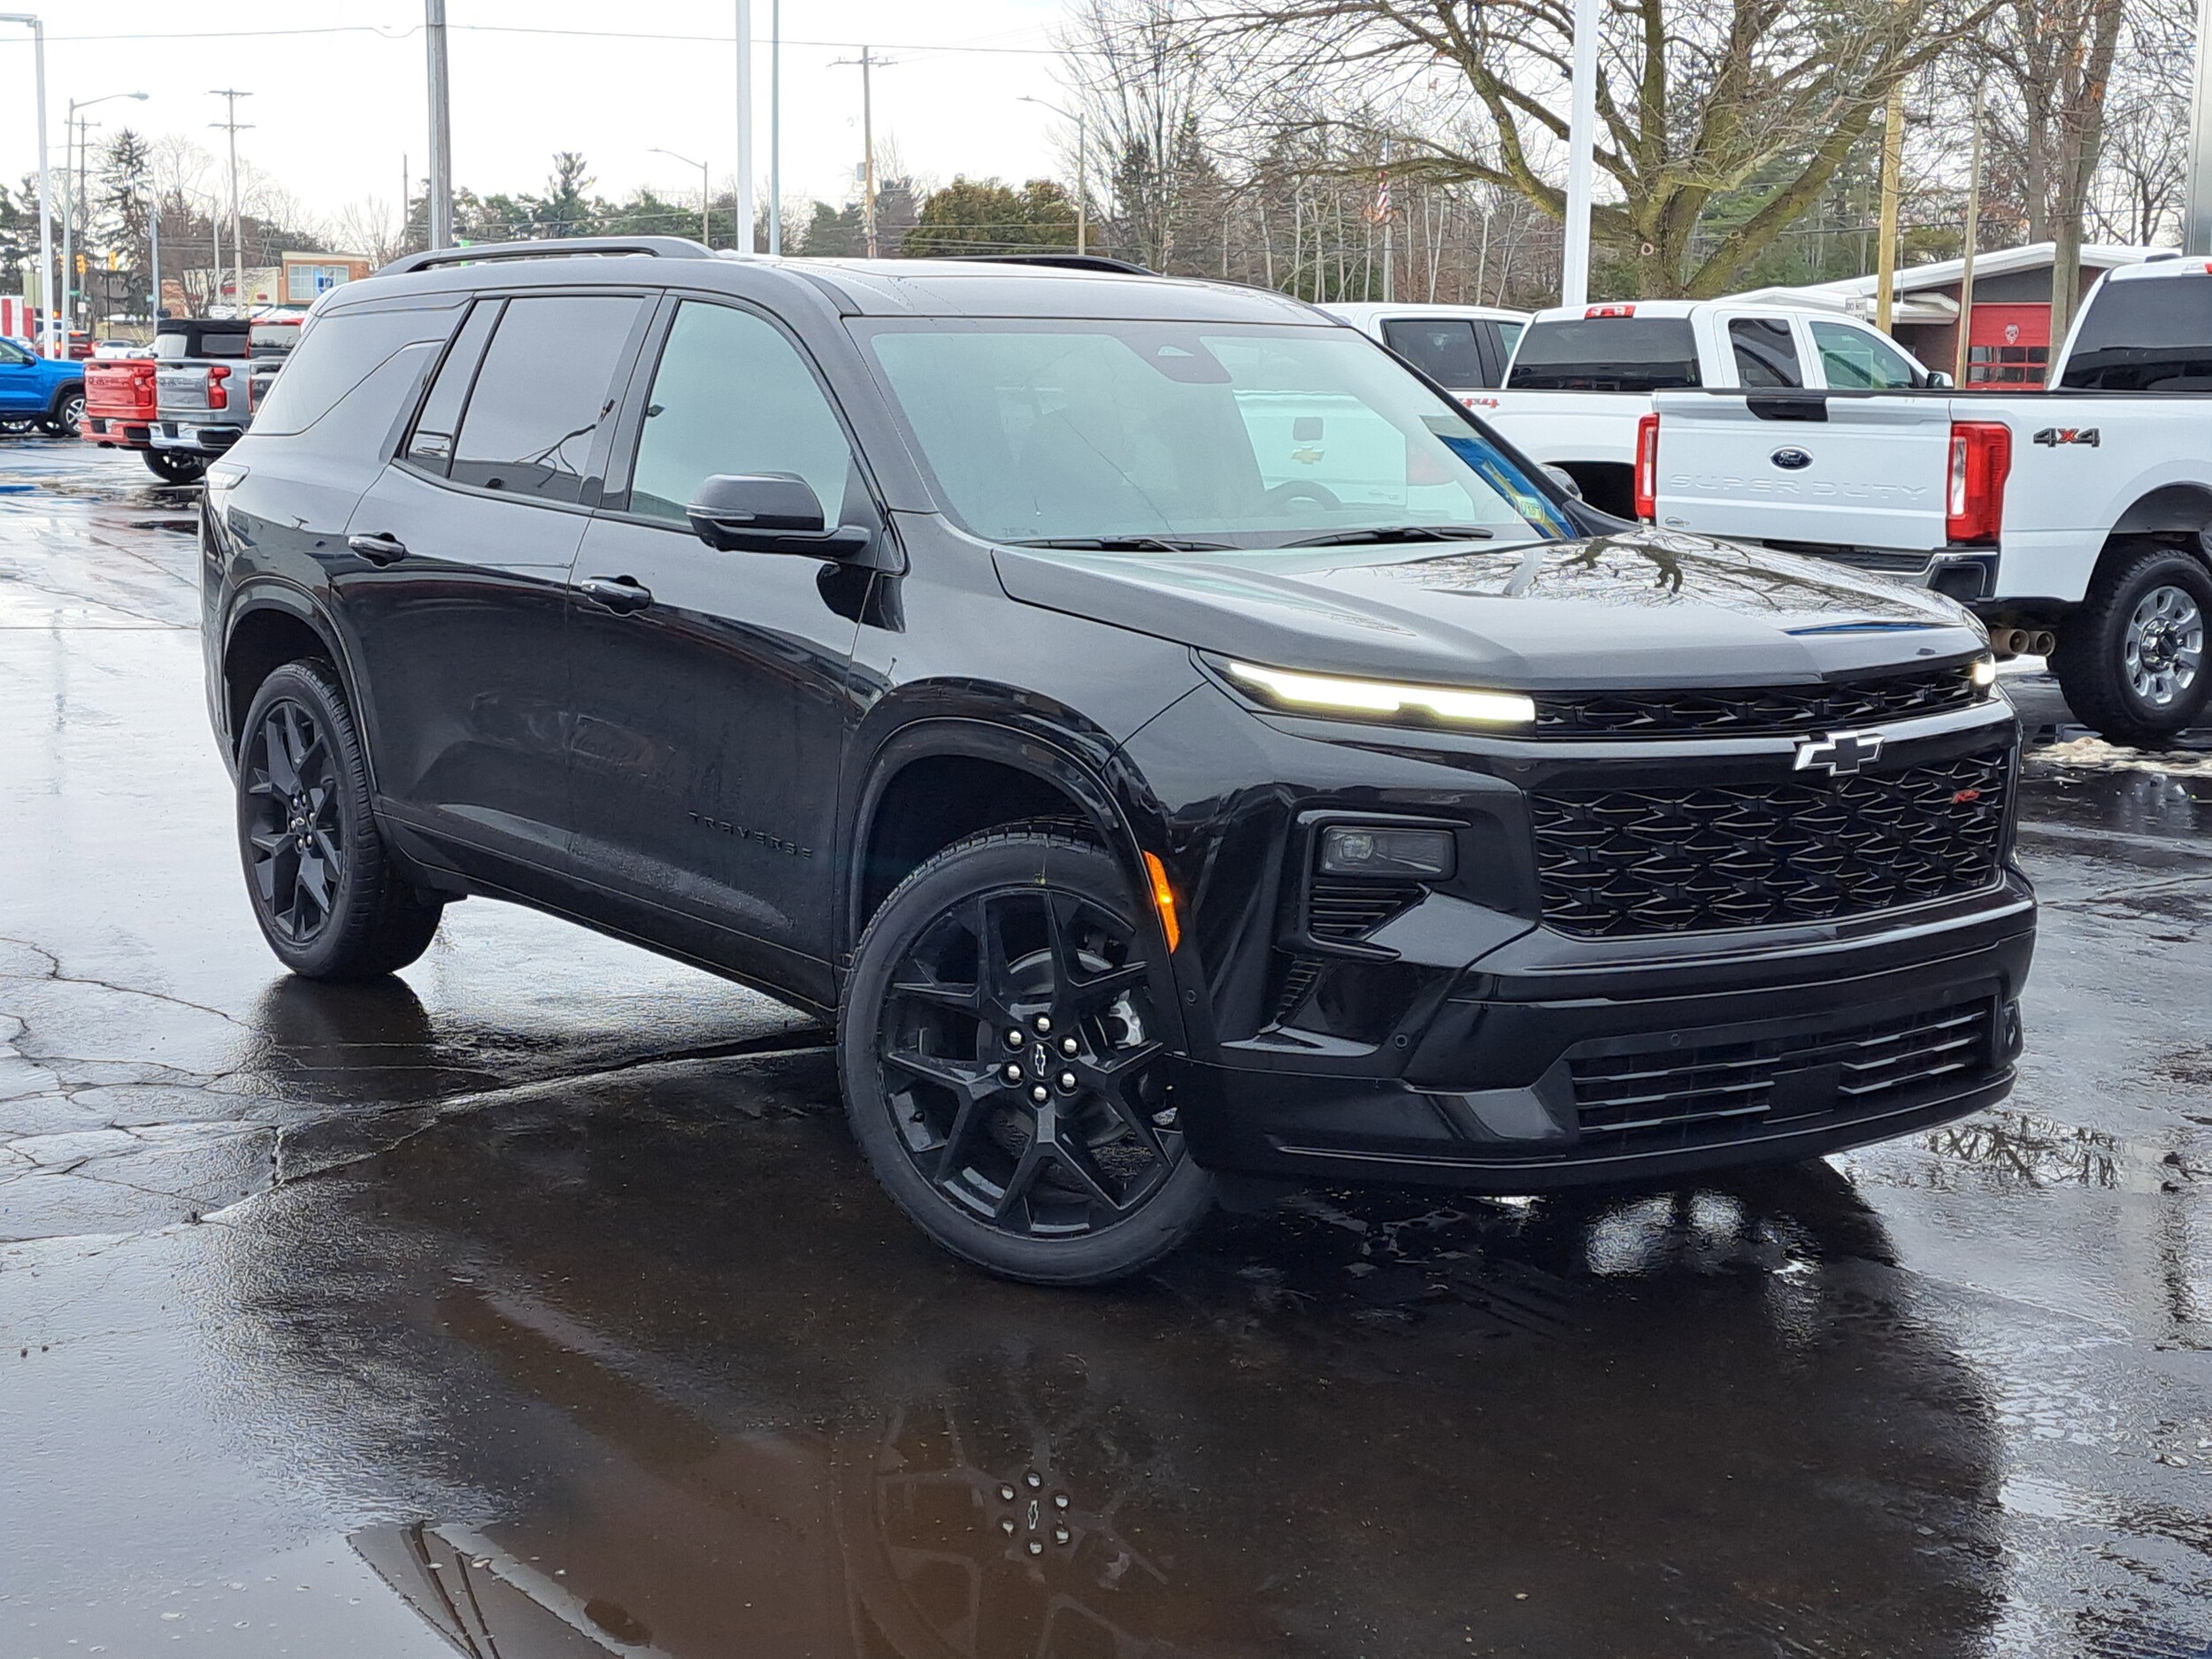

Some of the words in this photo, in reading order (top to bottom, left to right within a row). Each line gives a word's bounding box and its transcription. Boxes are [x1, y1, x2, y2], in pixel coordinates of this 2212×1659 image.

[1778, 450, 1802, 465] Ford
[1670, 473, 1800, 495] SUPER
[1813, 481, 1929, 501] DUTY
[687, 810, 813, 860] TRAVERSE
